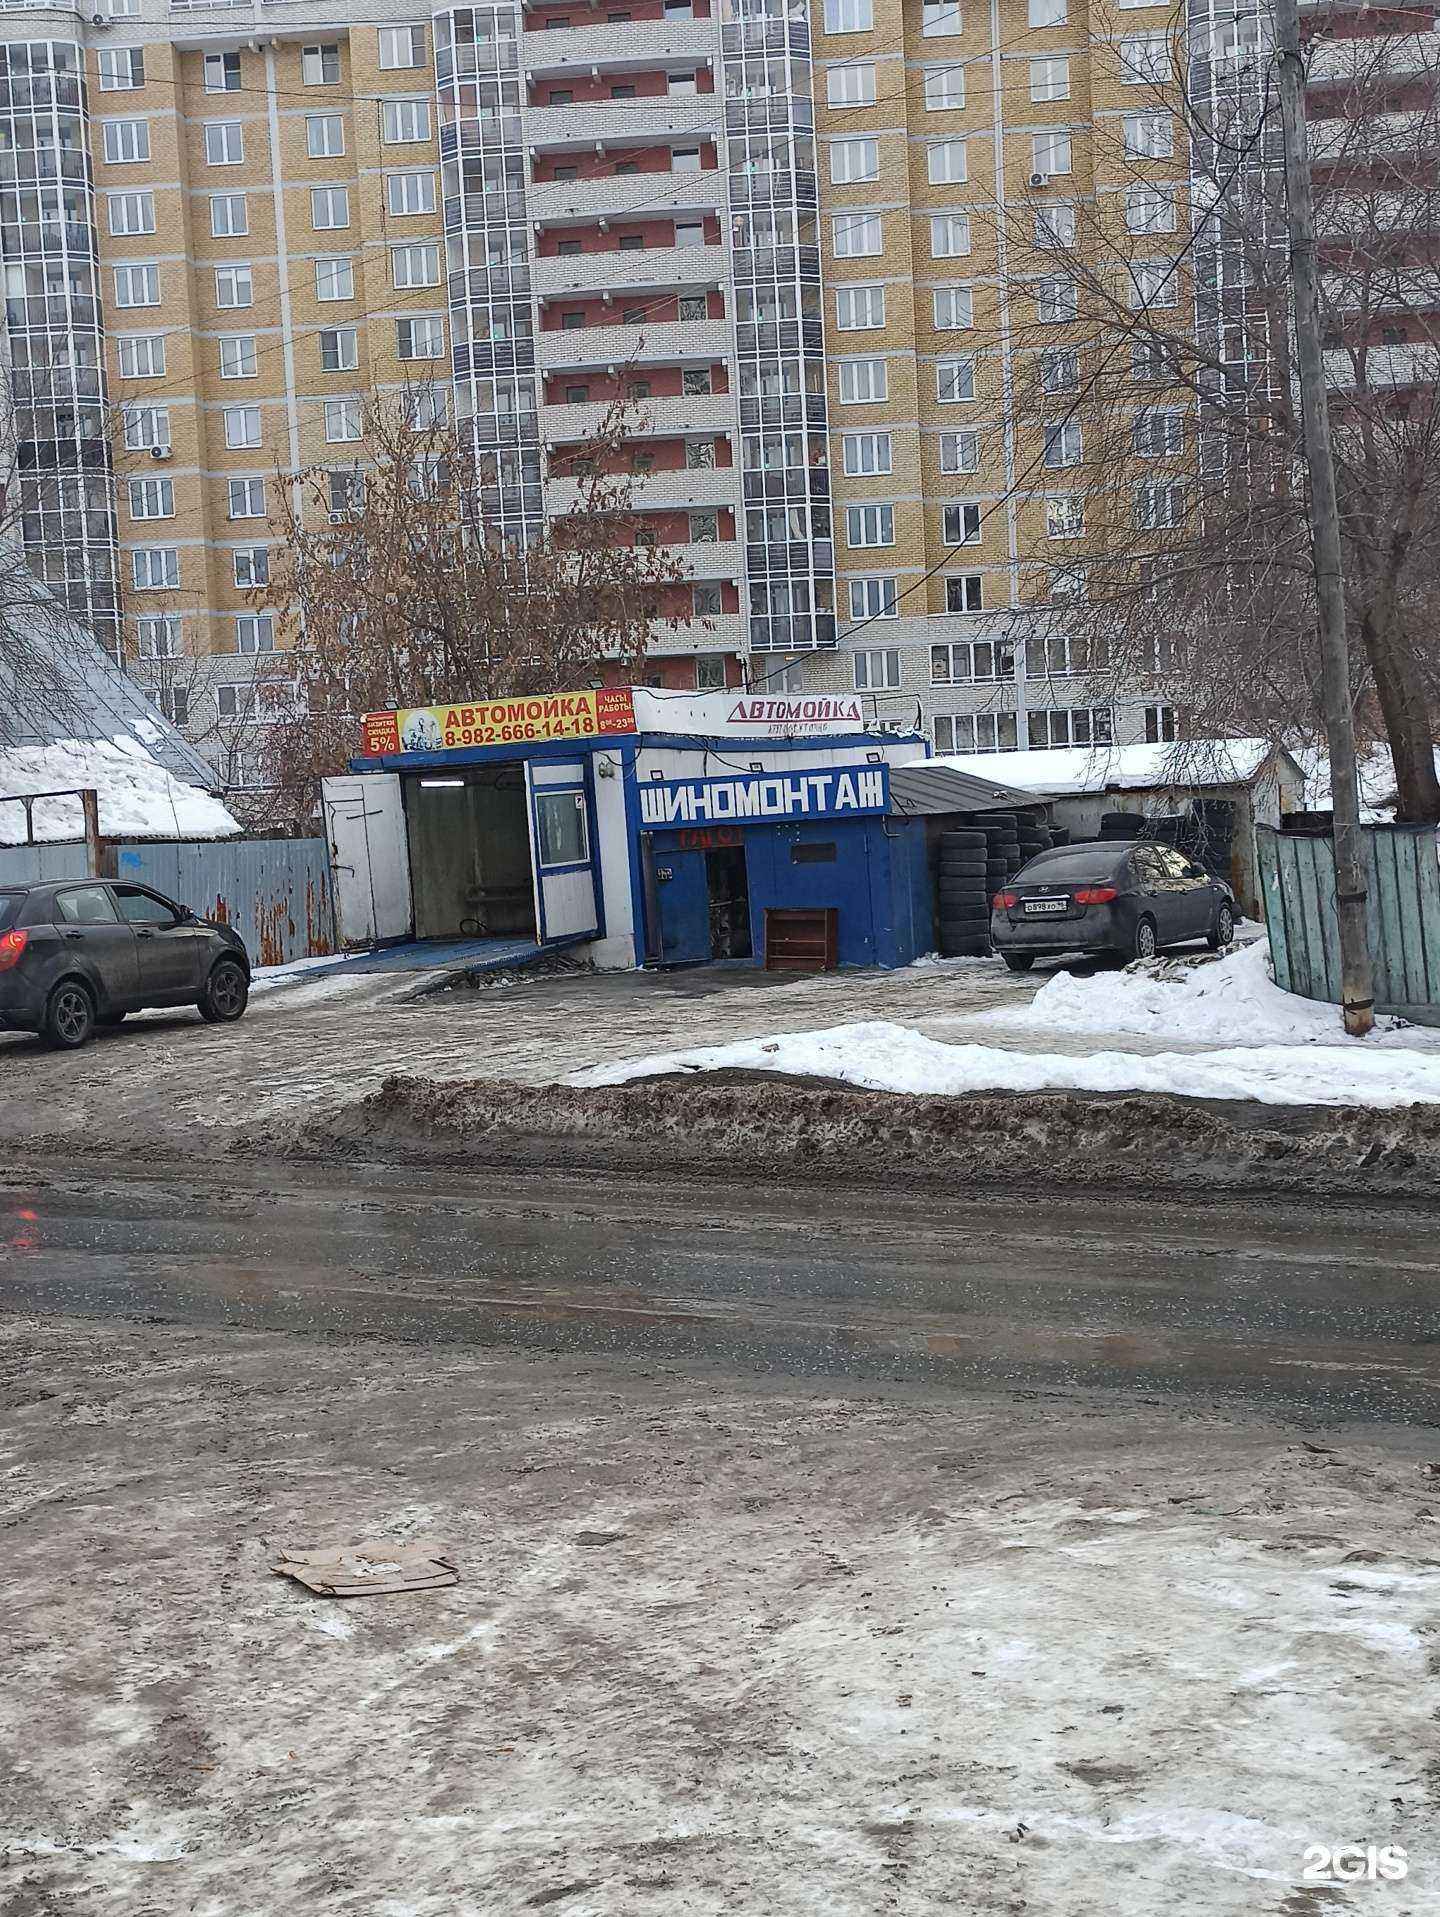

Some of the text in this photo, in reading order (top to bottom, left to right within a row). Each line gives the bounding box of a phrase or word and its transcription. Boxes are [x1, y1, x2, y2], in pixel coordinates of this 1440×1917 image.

[445, 695, 591, 728] АВТОМОЙКА
[598, 703, 632, 713] РАБОТЫ
[604, 695, 627, 704] ЧАСЫ
[727, 698, 860, 722] АВТОМОЙКА
[370, 736, 395, 752] 5%
[445, 717, 594, 747] 8-982-666-14-18
[640, 770, 884, 824] ШИНОМОНТАЖ
